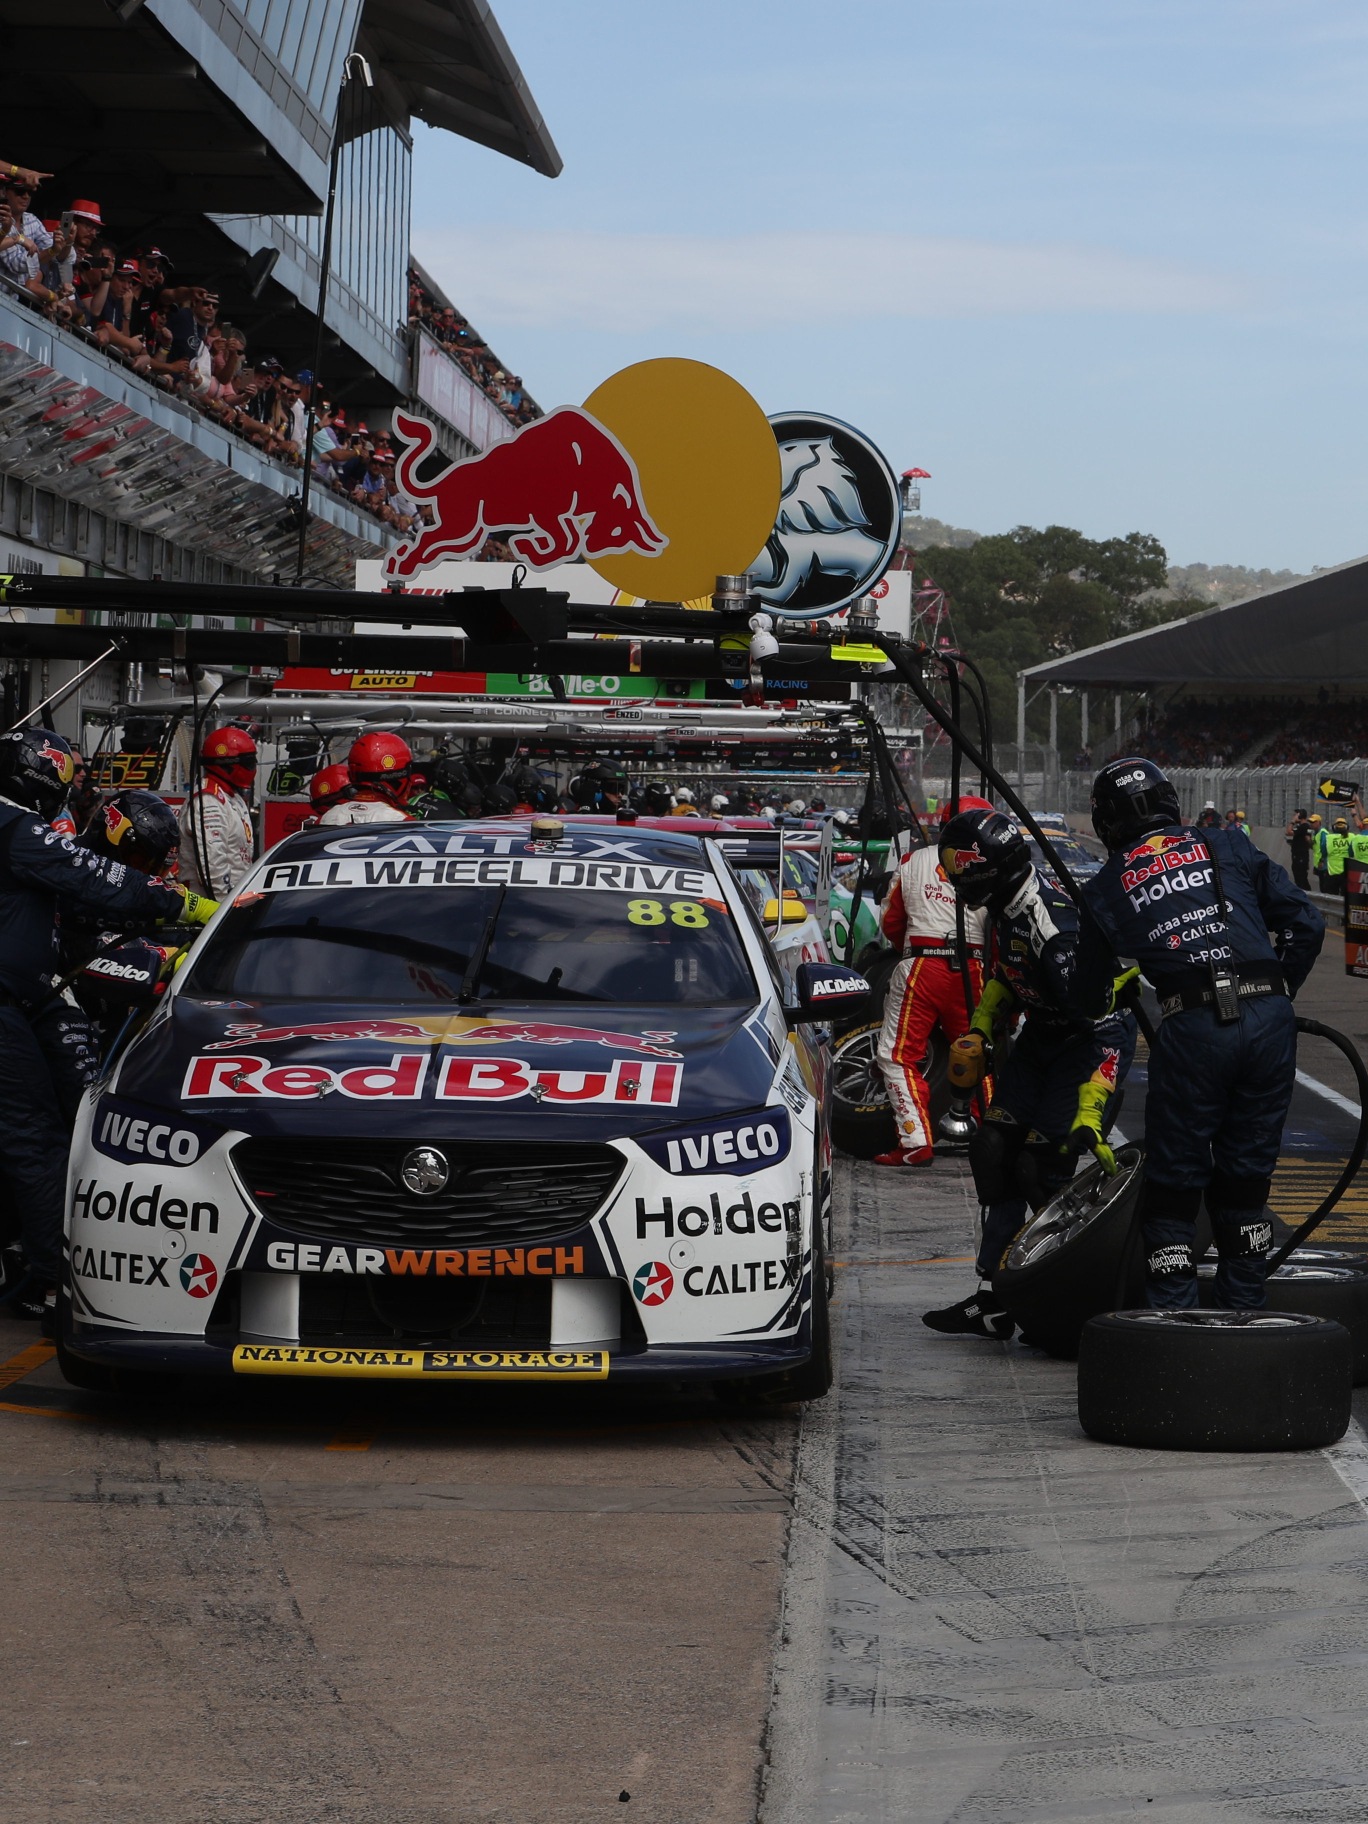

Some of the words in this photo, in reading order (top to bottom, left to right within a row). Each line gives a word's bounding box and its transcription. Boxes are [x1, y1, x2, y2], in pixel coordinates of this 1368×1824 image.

[358, 676, 408, 686] AUTO
[766, 680, 808, 690] RACING
[616, 710, 639, 719] ENZED
[323, 835, 652, 862] CALTEX
[263, 862, 353, 889] ALL
[364, 860, 538, 885] WHEEL
[549, 860, 705, 894] DRIVE
[1121, 856, 1164, 893] Red
[1163, 843, 1212, 870] Bull
[924, 884, 942, 892] Shell
[924, 890, 957, 904] V-Pow
[1128, 868, 1214, 914] Holden
[627, 899, 710, 929] 88
[1148, 914, 1181, 943] mtaa
[1183, 903, 1220, 924] super
[1182, 922, 1227, 942] CALTEX
[86, 957, 151, 982] ACDelco
[812, 977, 870, 996] ACDelco
[182, 1055, 431, 1099] Red
[437, 1056, 684, 1106] Bull
[100, 1112, 200, 1165] IVECO
[667, 1123, 780, 1174] IVECO
[73, 1179, 219, 1234] Holden
[635, 1192, 801, 1239] Holden
[73, 1247, 170, 1287] CALTEX
[266, 1242, 584, 1277] GEARWRENCH
[684, 1259, 797, 1298] CALTEX
[965, 1304, 980, 1317] OMP
[240, 1347, 413, 1366] NATIONAL
[432, 1352, 594, 1368] STORAGE
